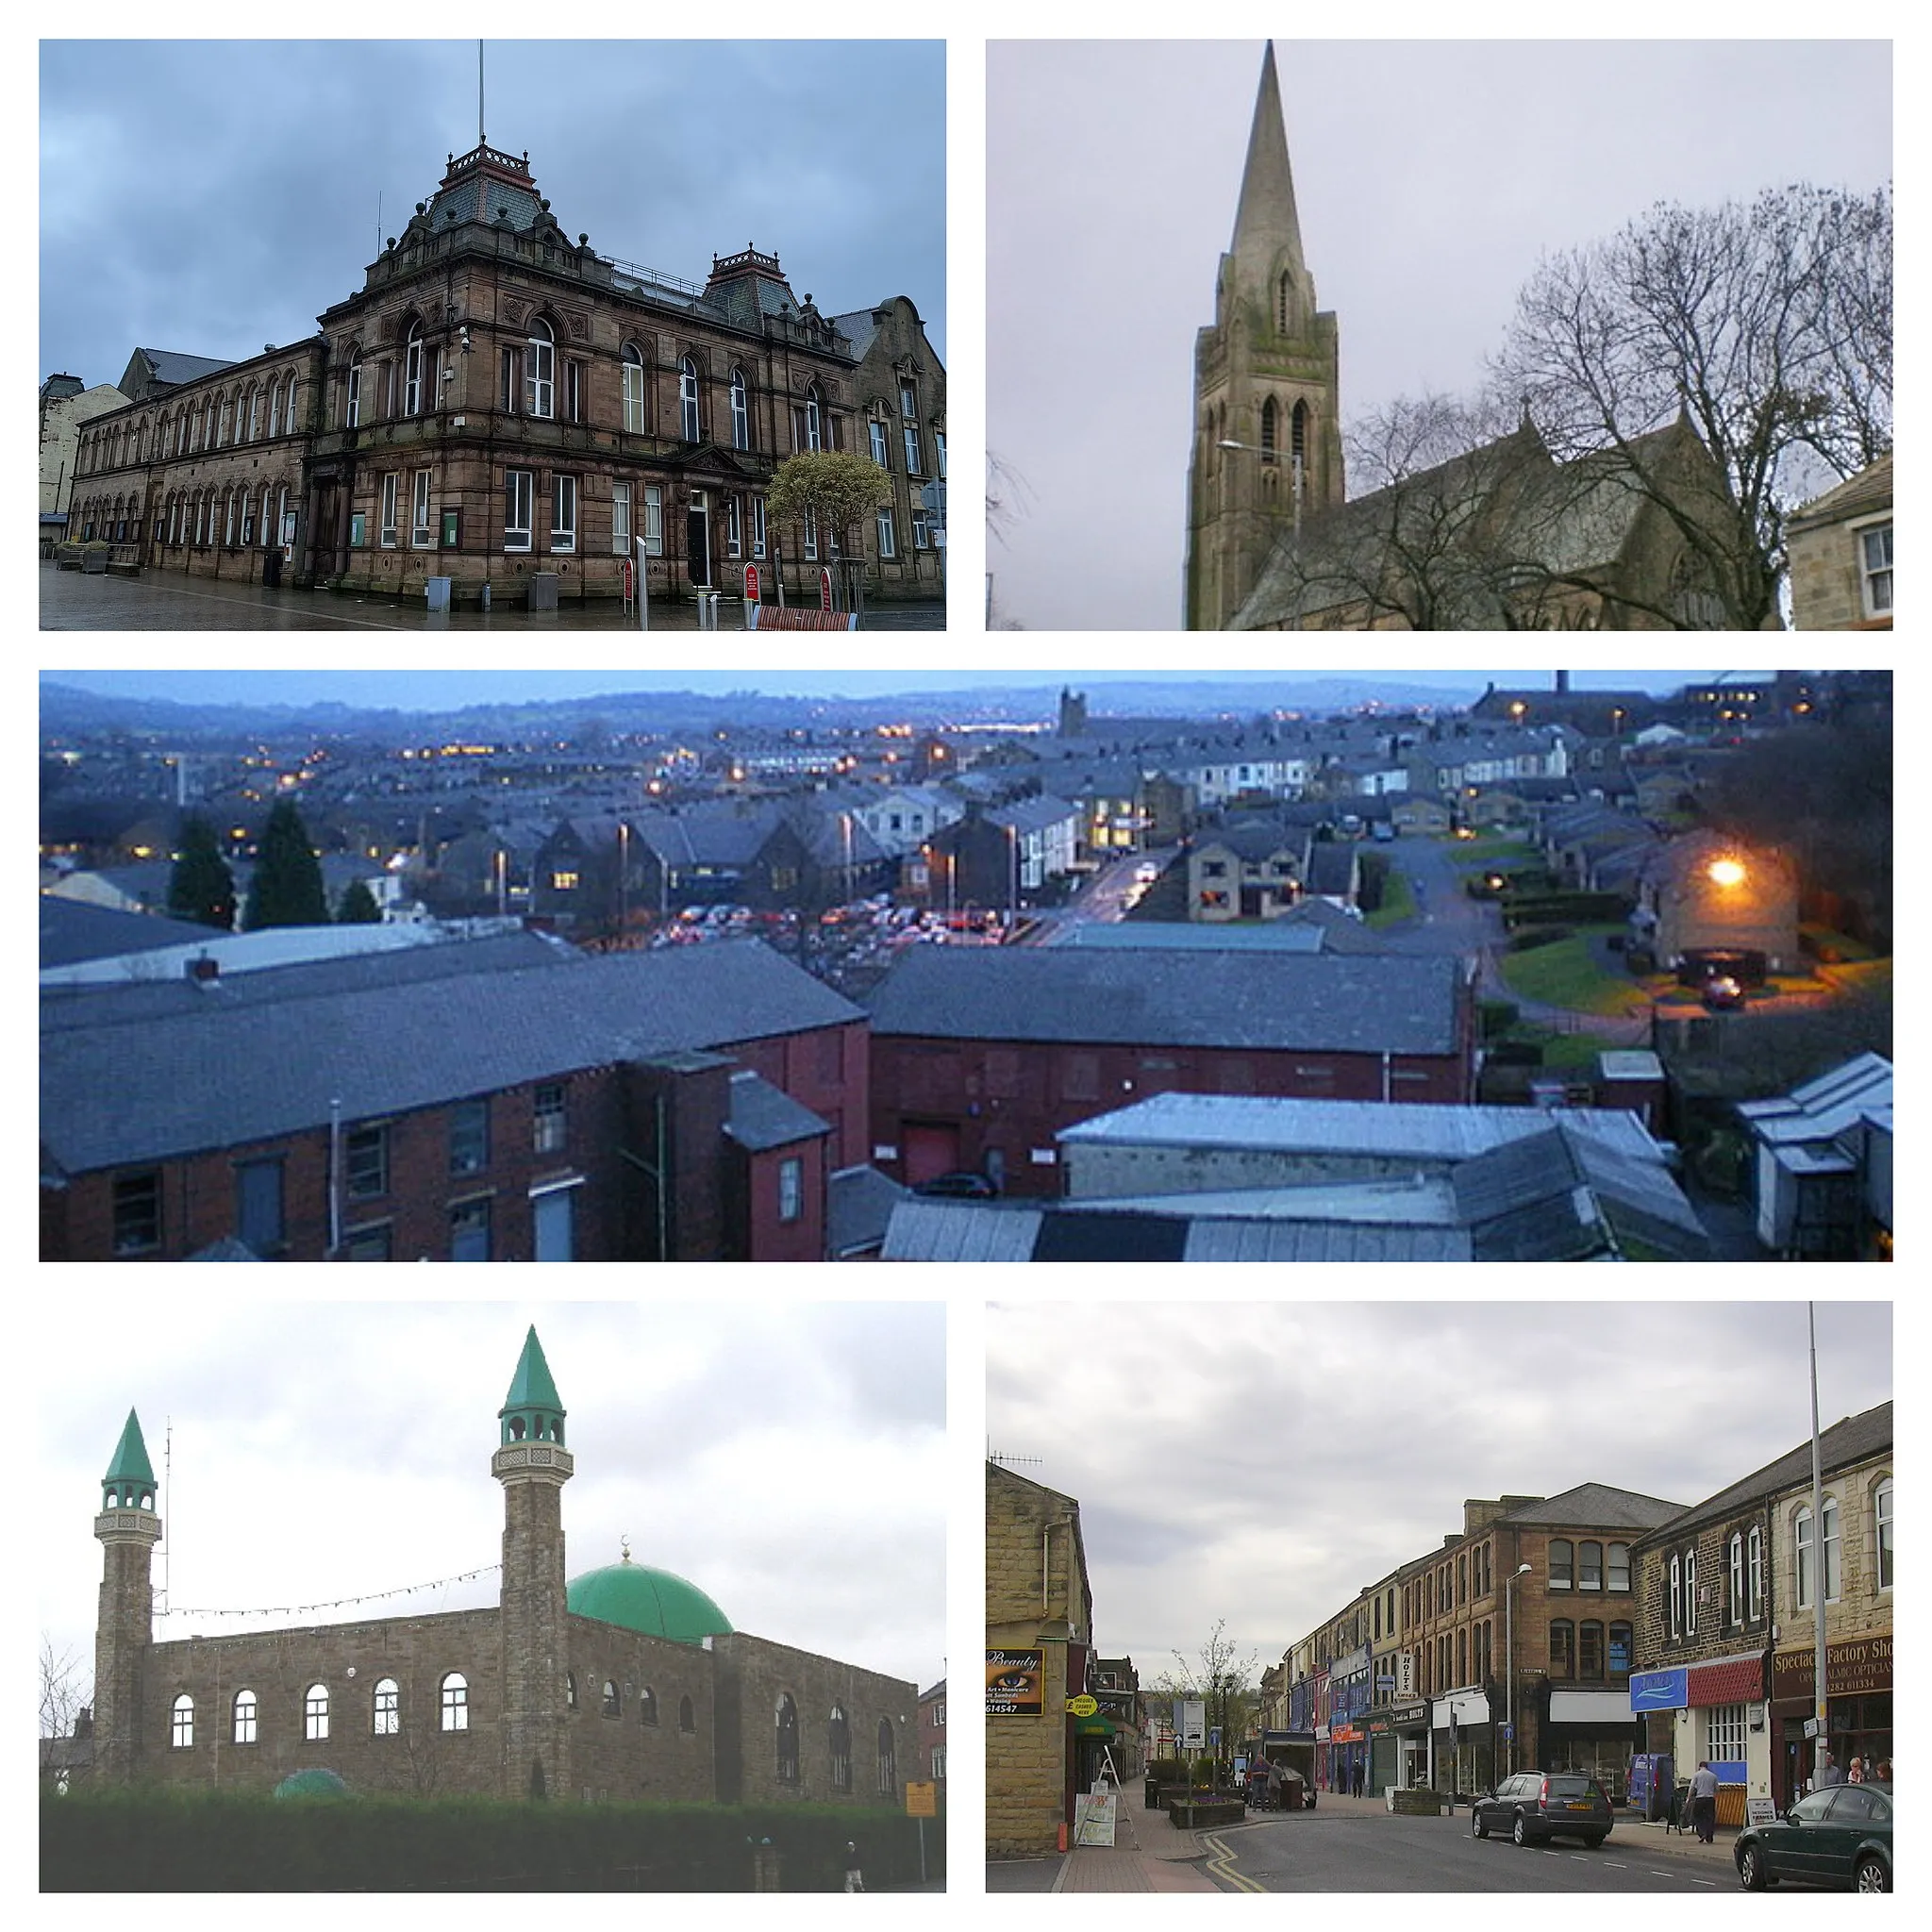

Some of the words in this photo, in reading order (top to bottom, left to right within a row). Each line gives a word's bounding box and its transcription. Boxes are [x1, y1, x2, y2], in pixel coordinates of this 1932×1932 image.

[986, 1650, 1038, 1673] Beauty
[1774, 1653, 1815, 1674] Spectac
[1827, 1645, 1868, 1664] Factory
[1403, 1657, 1411, 1690] HOLTS
[1826, 1682, 1845, 1692] 1282
[1846, 1678, 1875, 1690] 611334
[985, 1705, 1018, 1713] 614547
[1067, 1701, 1074, 1709] £
